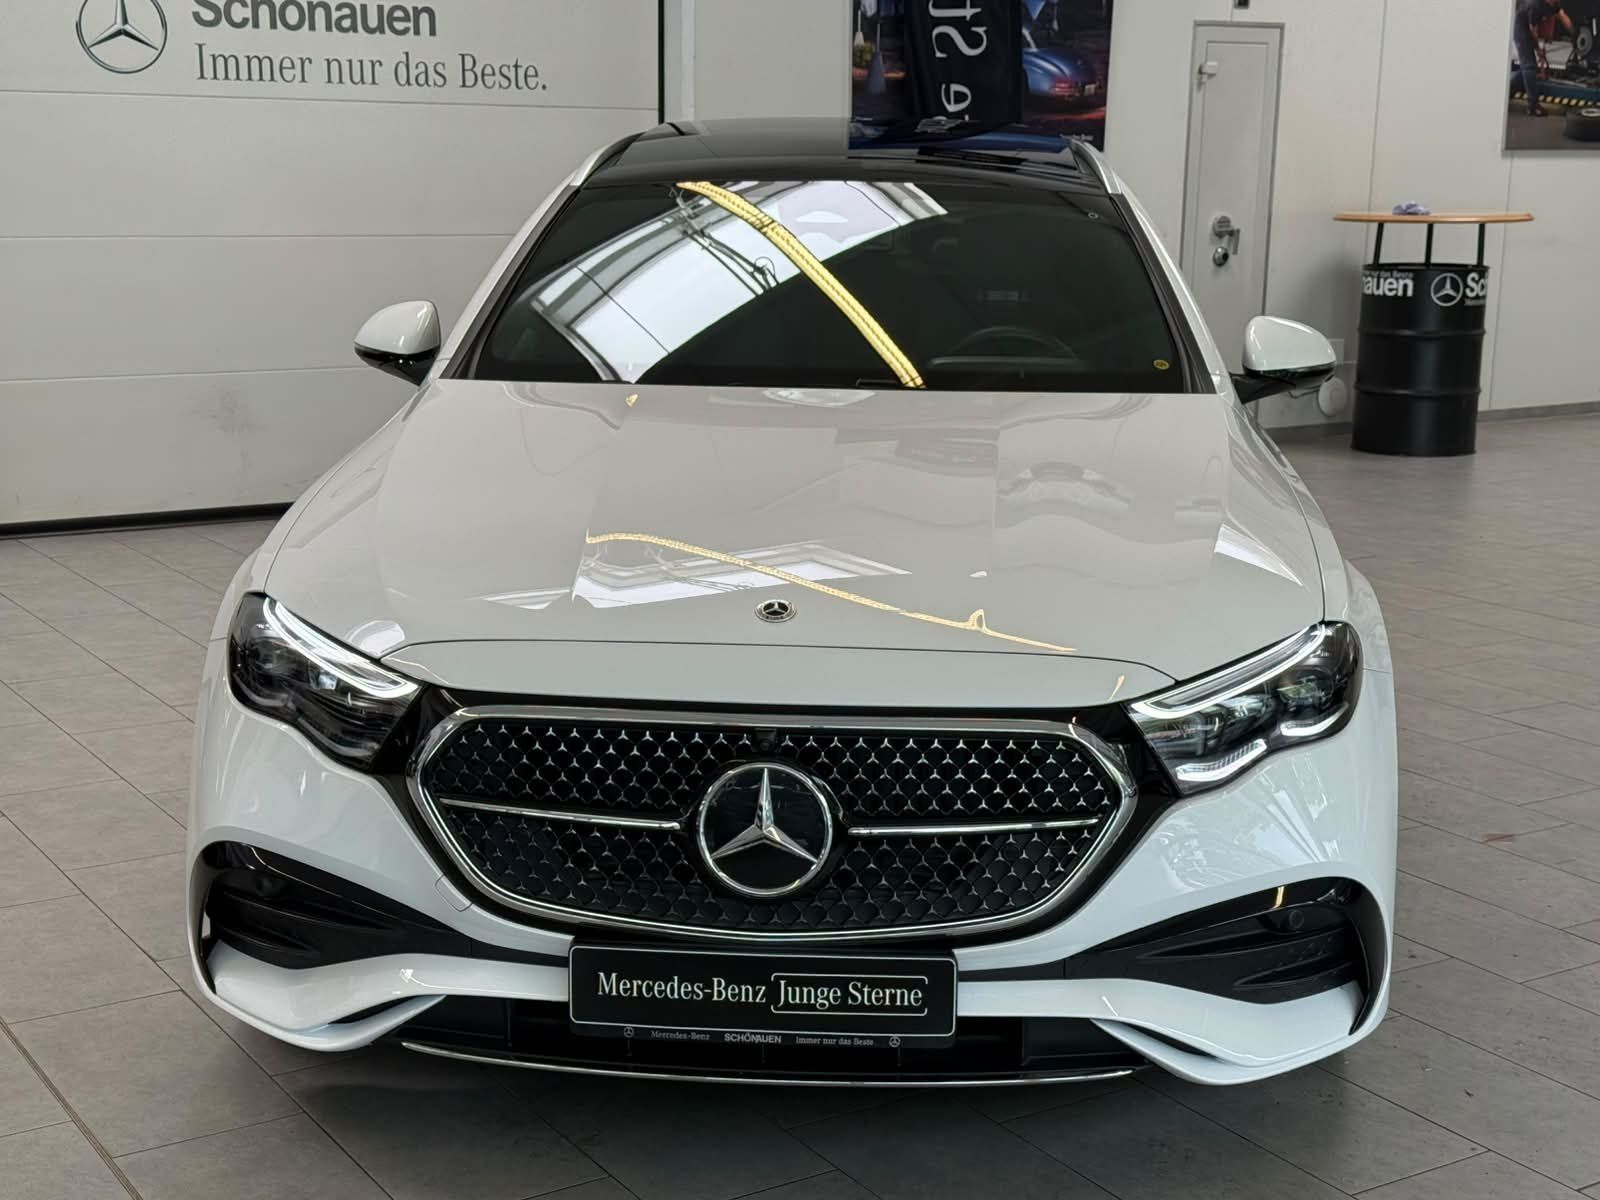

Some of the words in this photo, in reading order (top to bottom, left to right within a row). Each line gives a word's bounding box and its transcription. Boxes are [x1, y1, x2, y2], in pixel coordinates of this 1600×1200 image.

[194, 43, 313, 84] Immer
[324, 56, 383, 86] nur
[394, 51, 447, 88] das
[458, 53, 548, 91] Beste.
[597, 971, 767, 1004] Mercedes-Benz
[777, 980, 842, 1010] Junge
[848, 981, 923, 1007] Sterne
